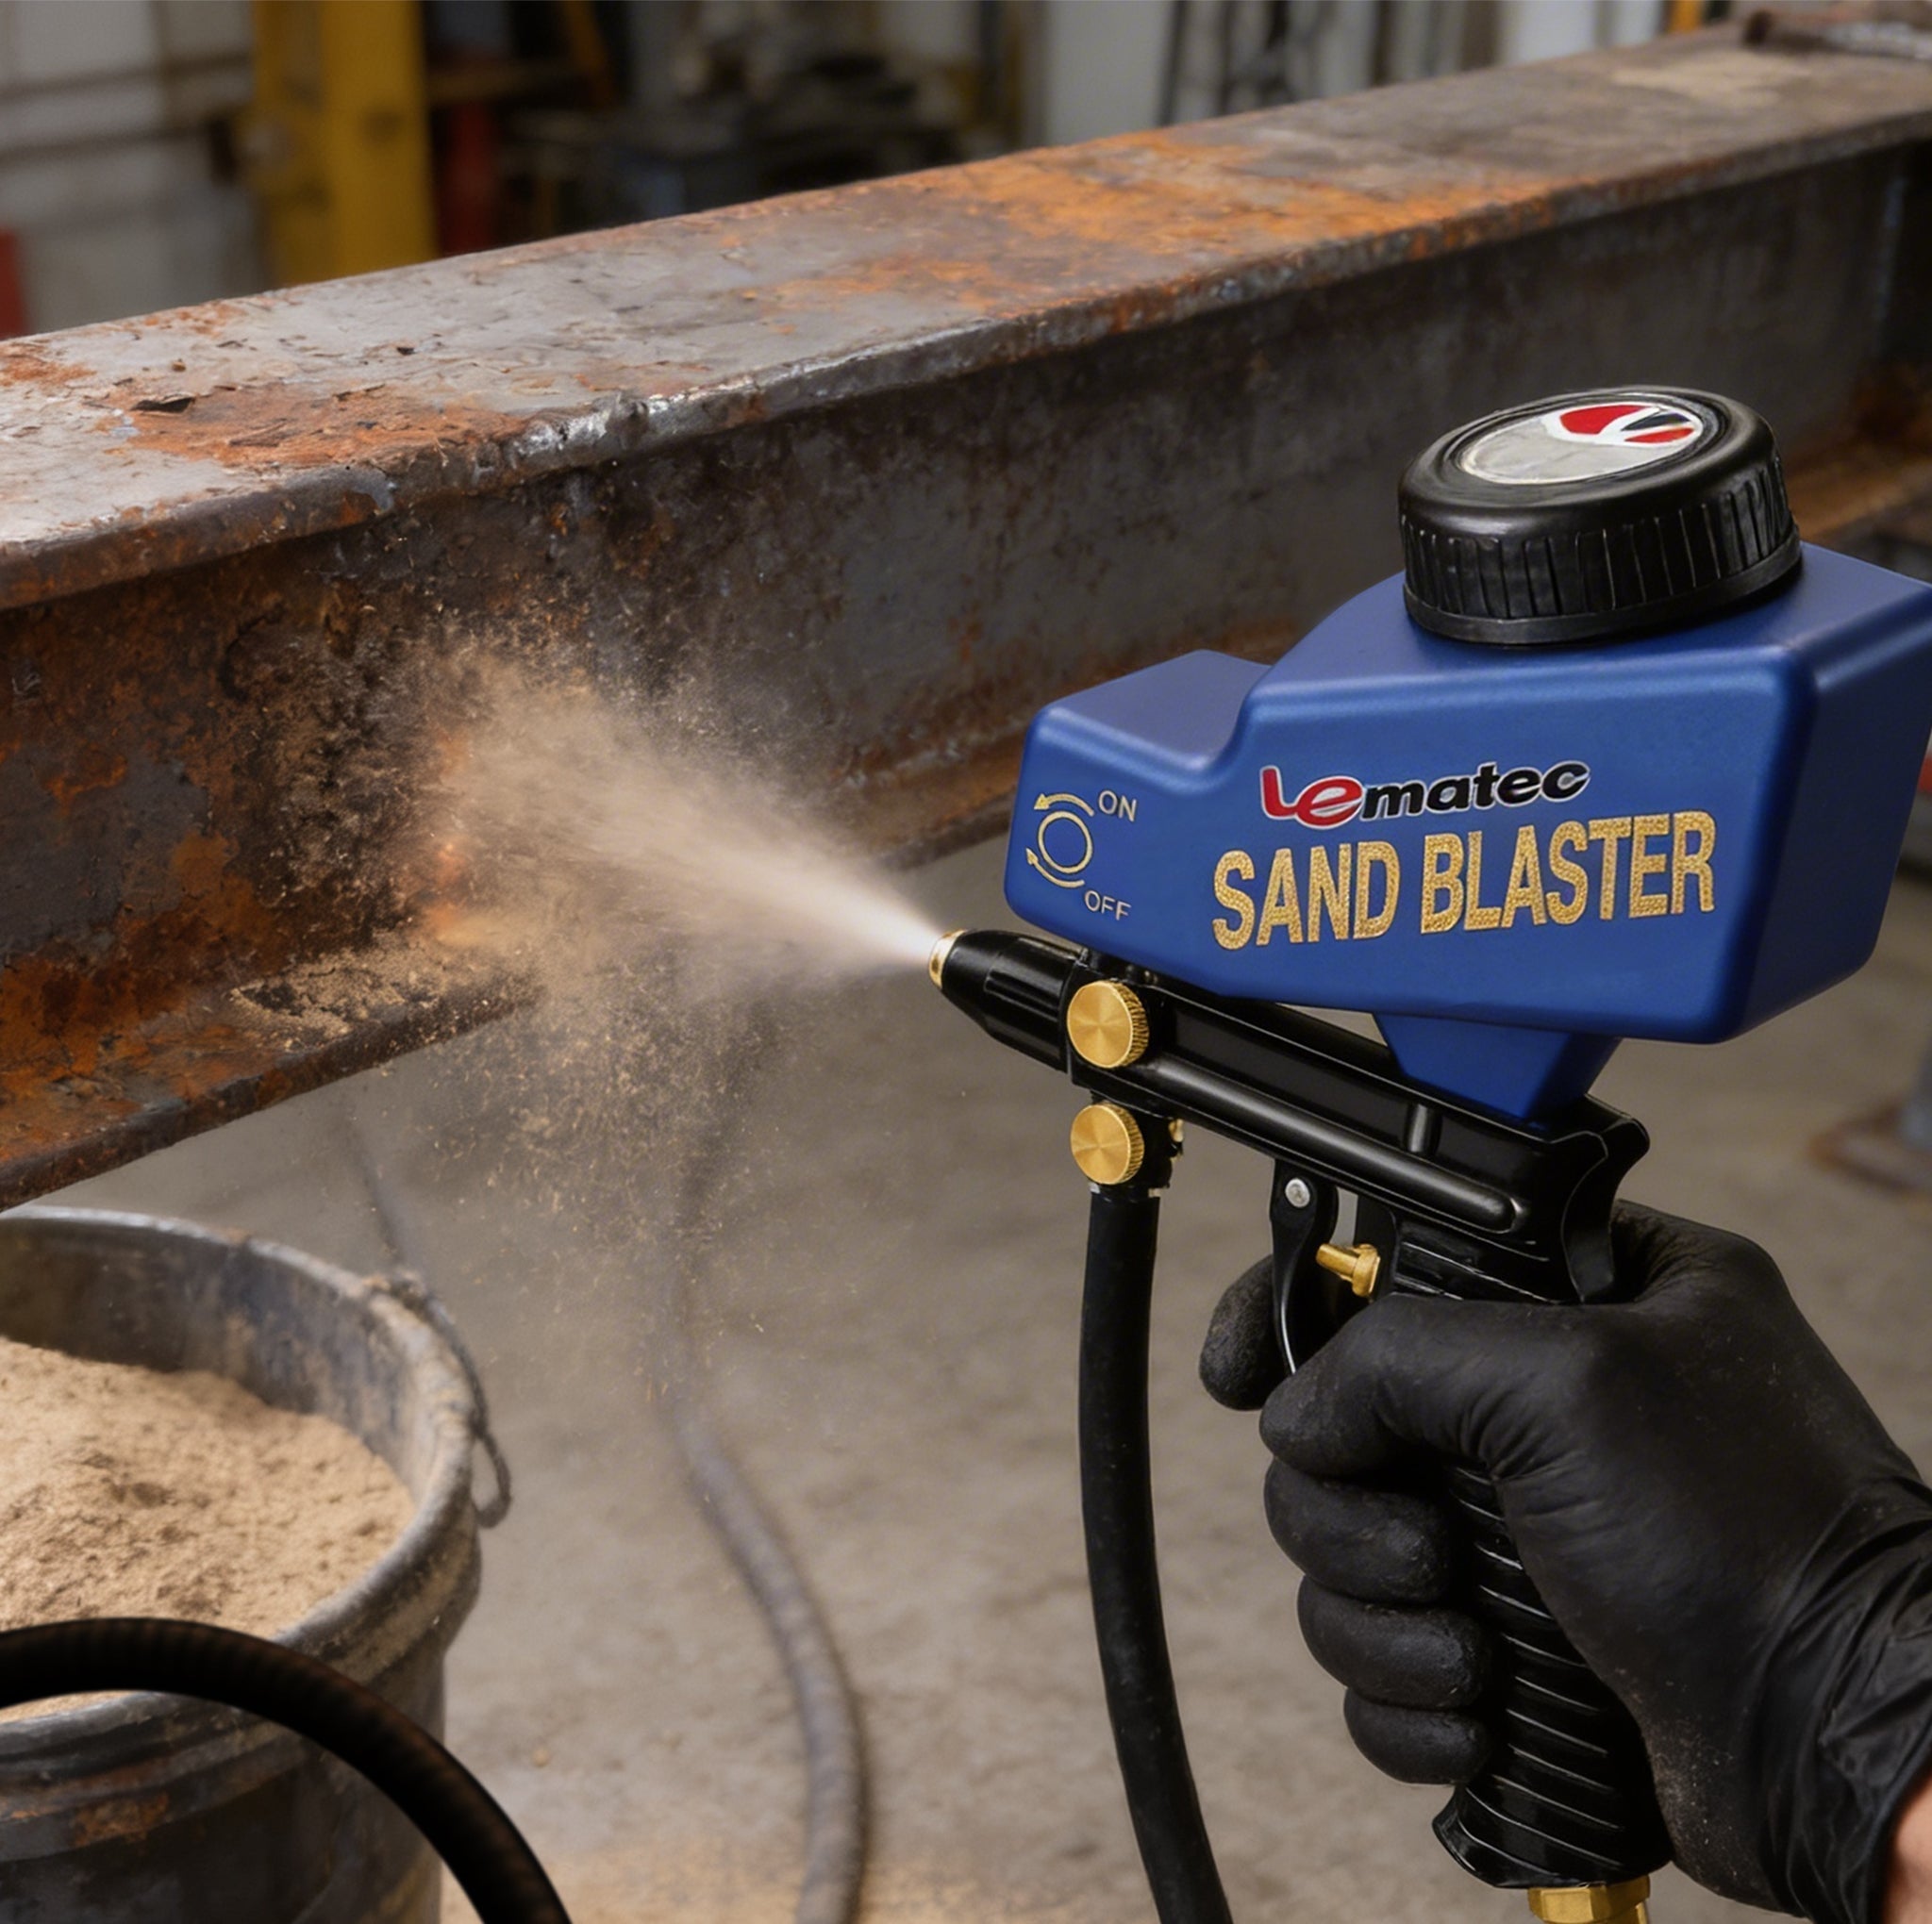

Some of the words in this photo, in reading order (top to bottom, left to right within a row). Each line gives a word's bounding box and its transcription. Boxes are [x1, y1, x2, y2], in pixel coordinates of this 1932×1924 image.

[1098, 790, 1138, 821] ON
[1259, 761, 1591, 829] Lematec
[1211, 840, 1401, 951] SAND
[1420, 809, 1717, 934] BLASTER
[1085, 890, 1132, 921] OFF
